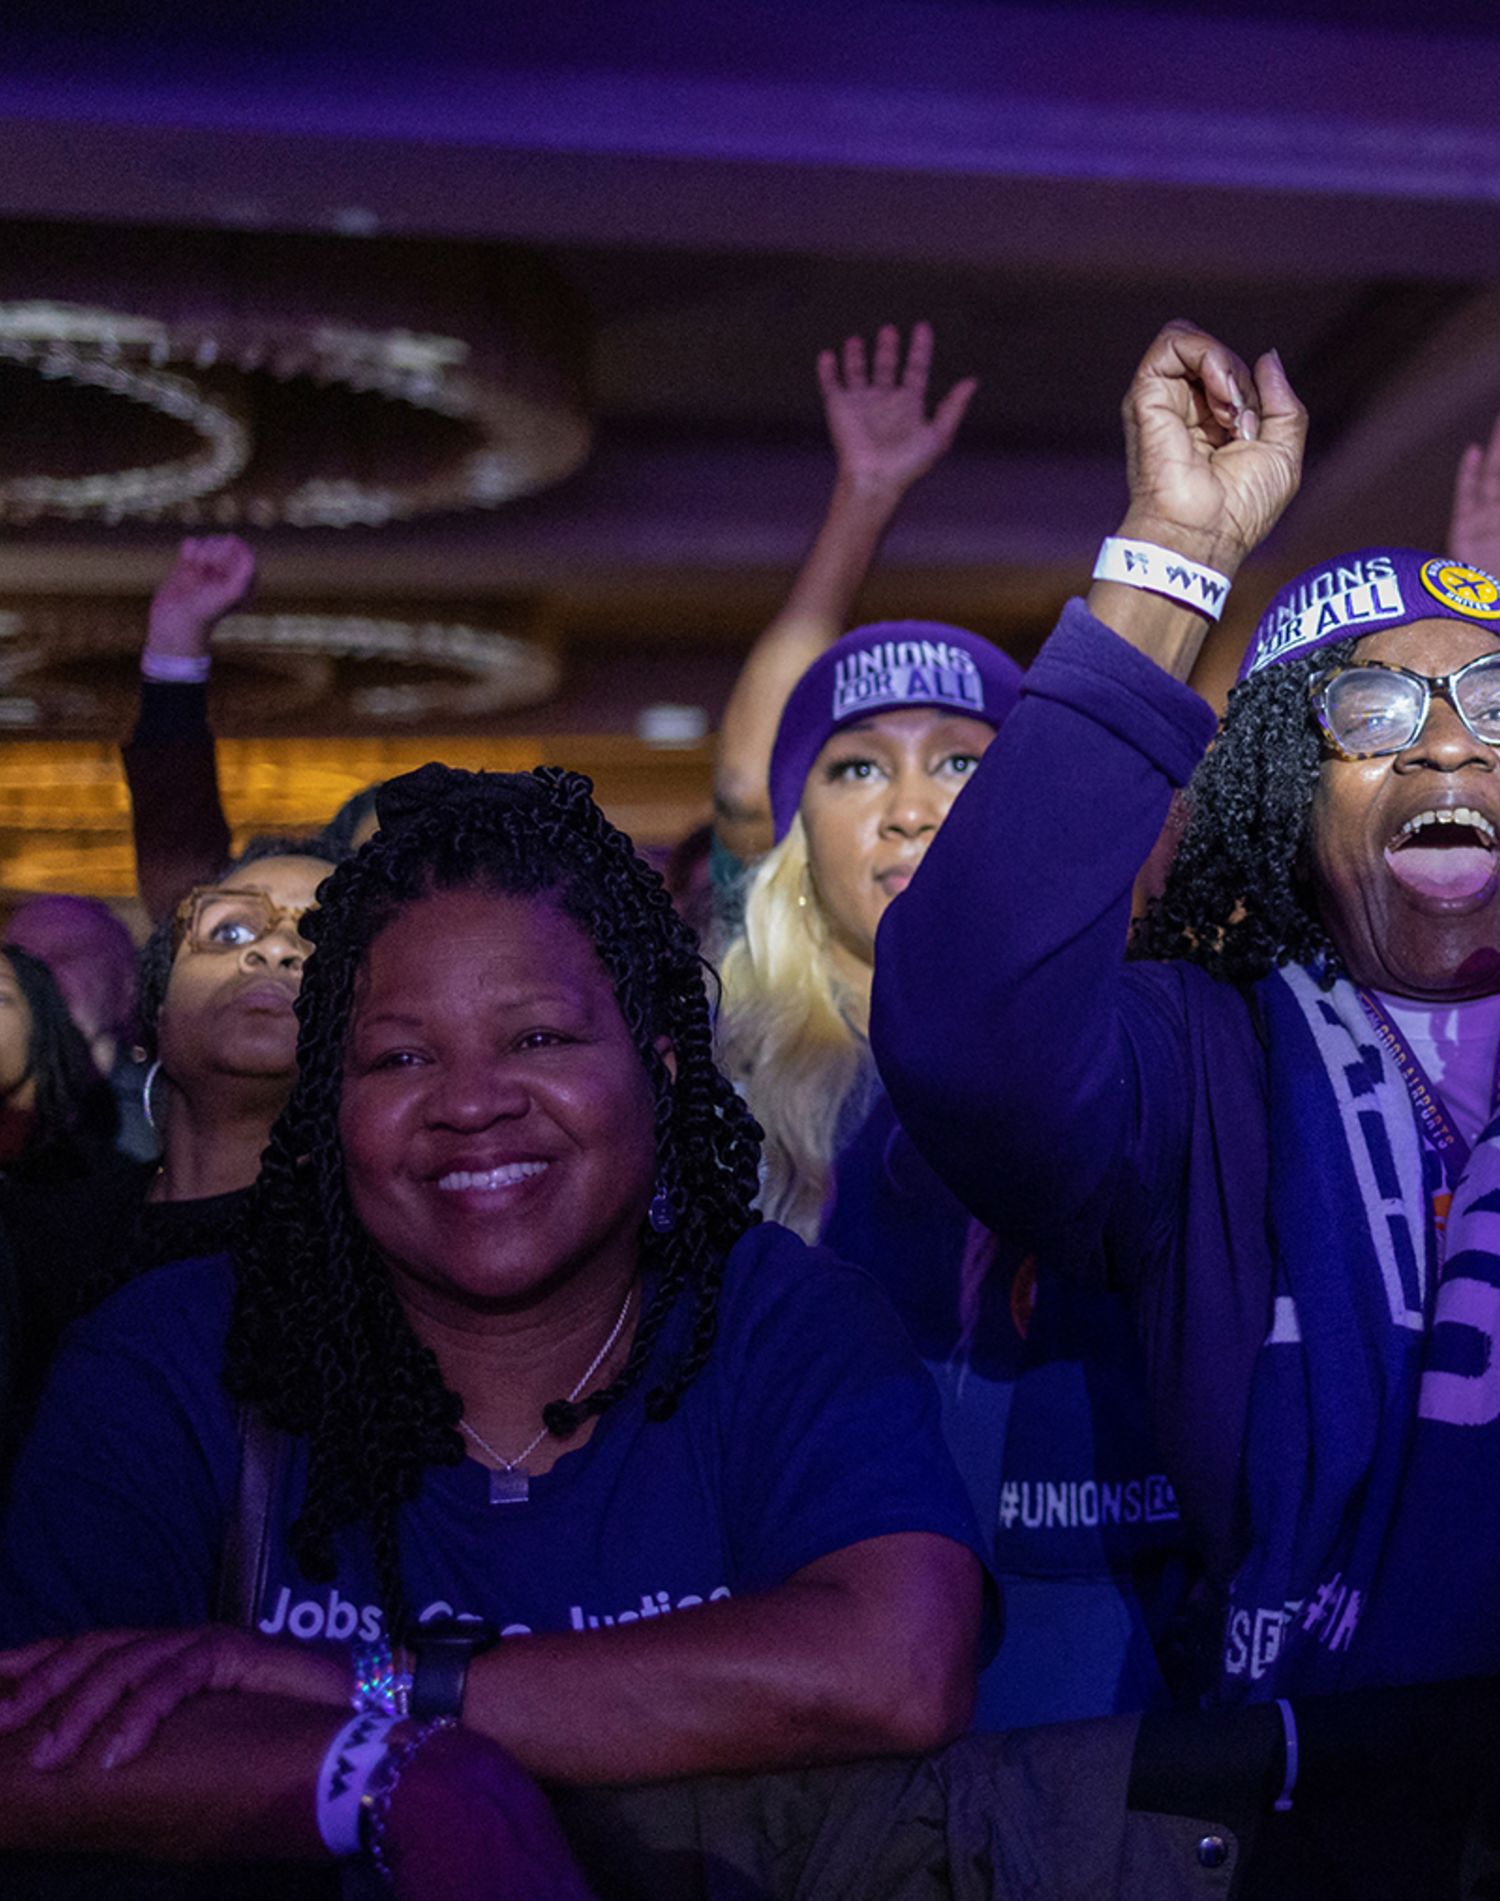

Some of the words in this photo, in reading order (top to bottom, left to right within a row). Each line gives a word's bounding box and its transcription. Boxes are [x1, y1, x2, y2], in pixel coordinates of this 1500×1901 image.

[1256, 556, 1395, 656] UNIONS
[1316, 582, 1399, 636] ALL
[834, 640, 976, 684] UNIONS
[840, 673, 892, 705] FOR
[907, 669, 977, 704] ALL
[259, 1585, 384, 1642] Jobs
